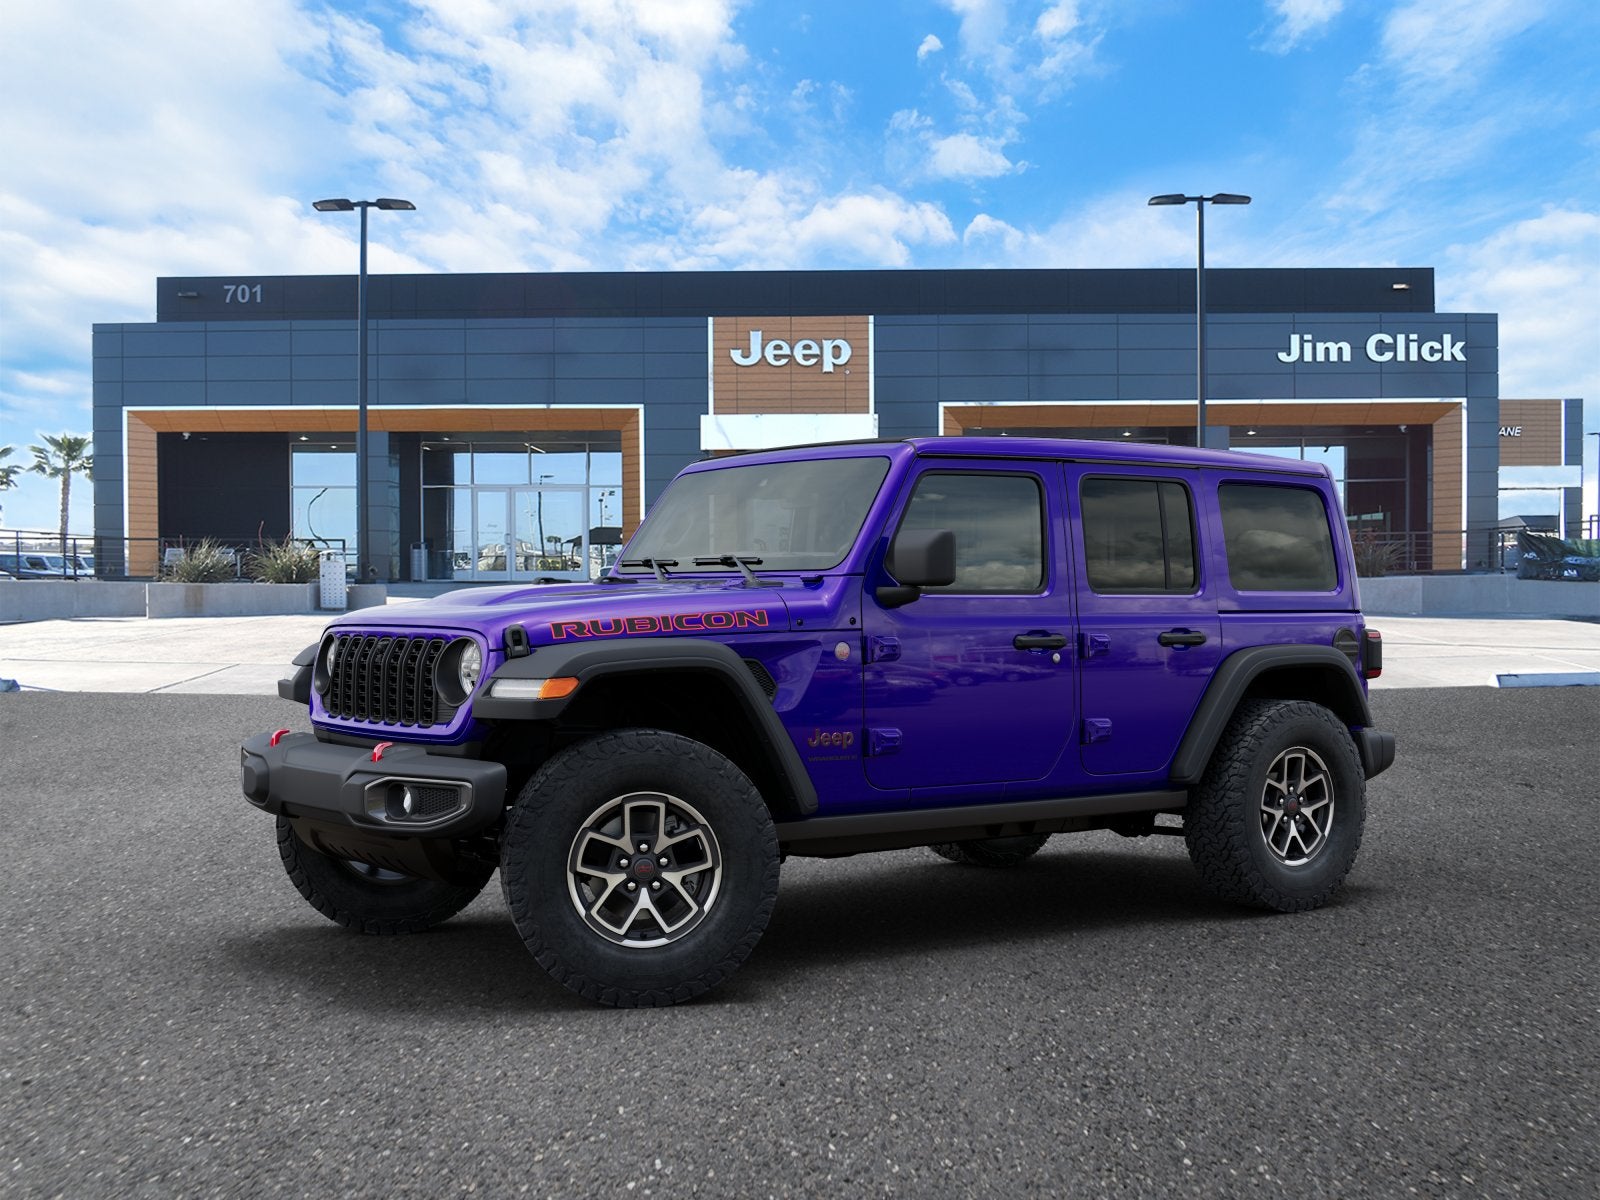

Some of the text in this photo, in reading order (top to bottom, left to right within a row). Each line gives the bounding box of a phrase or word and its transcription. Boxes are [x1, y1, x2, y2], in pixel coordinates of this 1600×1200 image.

[223, 284, 262, 303] 701
[729, 329, 852, 373] Jeep
[1277, 333, 1467, 363] Jim Click
[551, 609, 769, 640] RUBICON
[808, 728, 854, 749] Jeep
